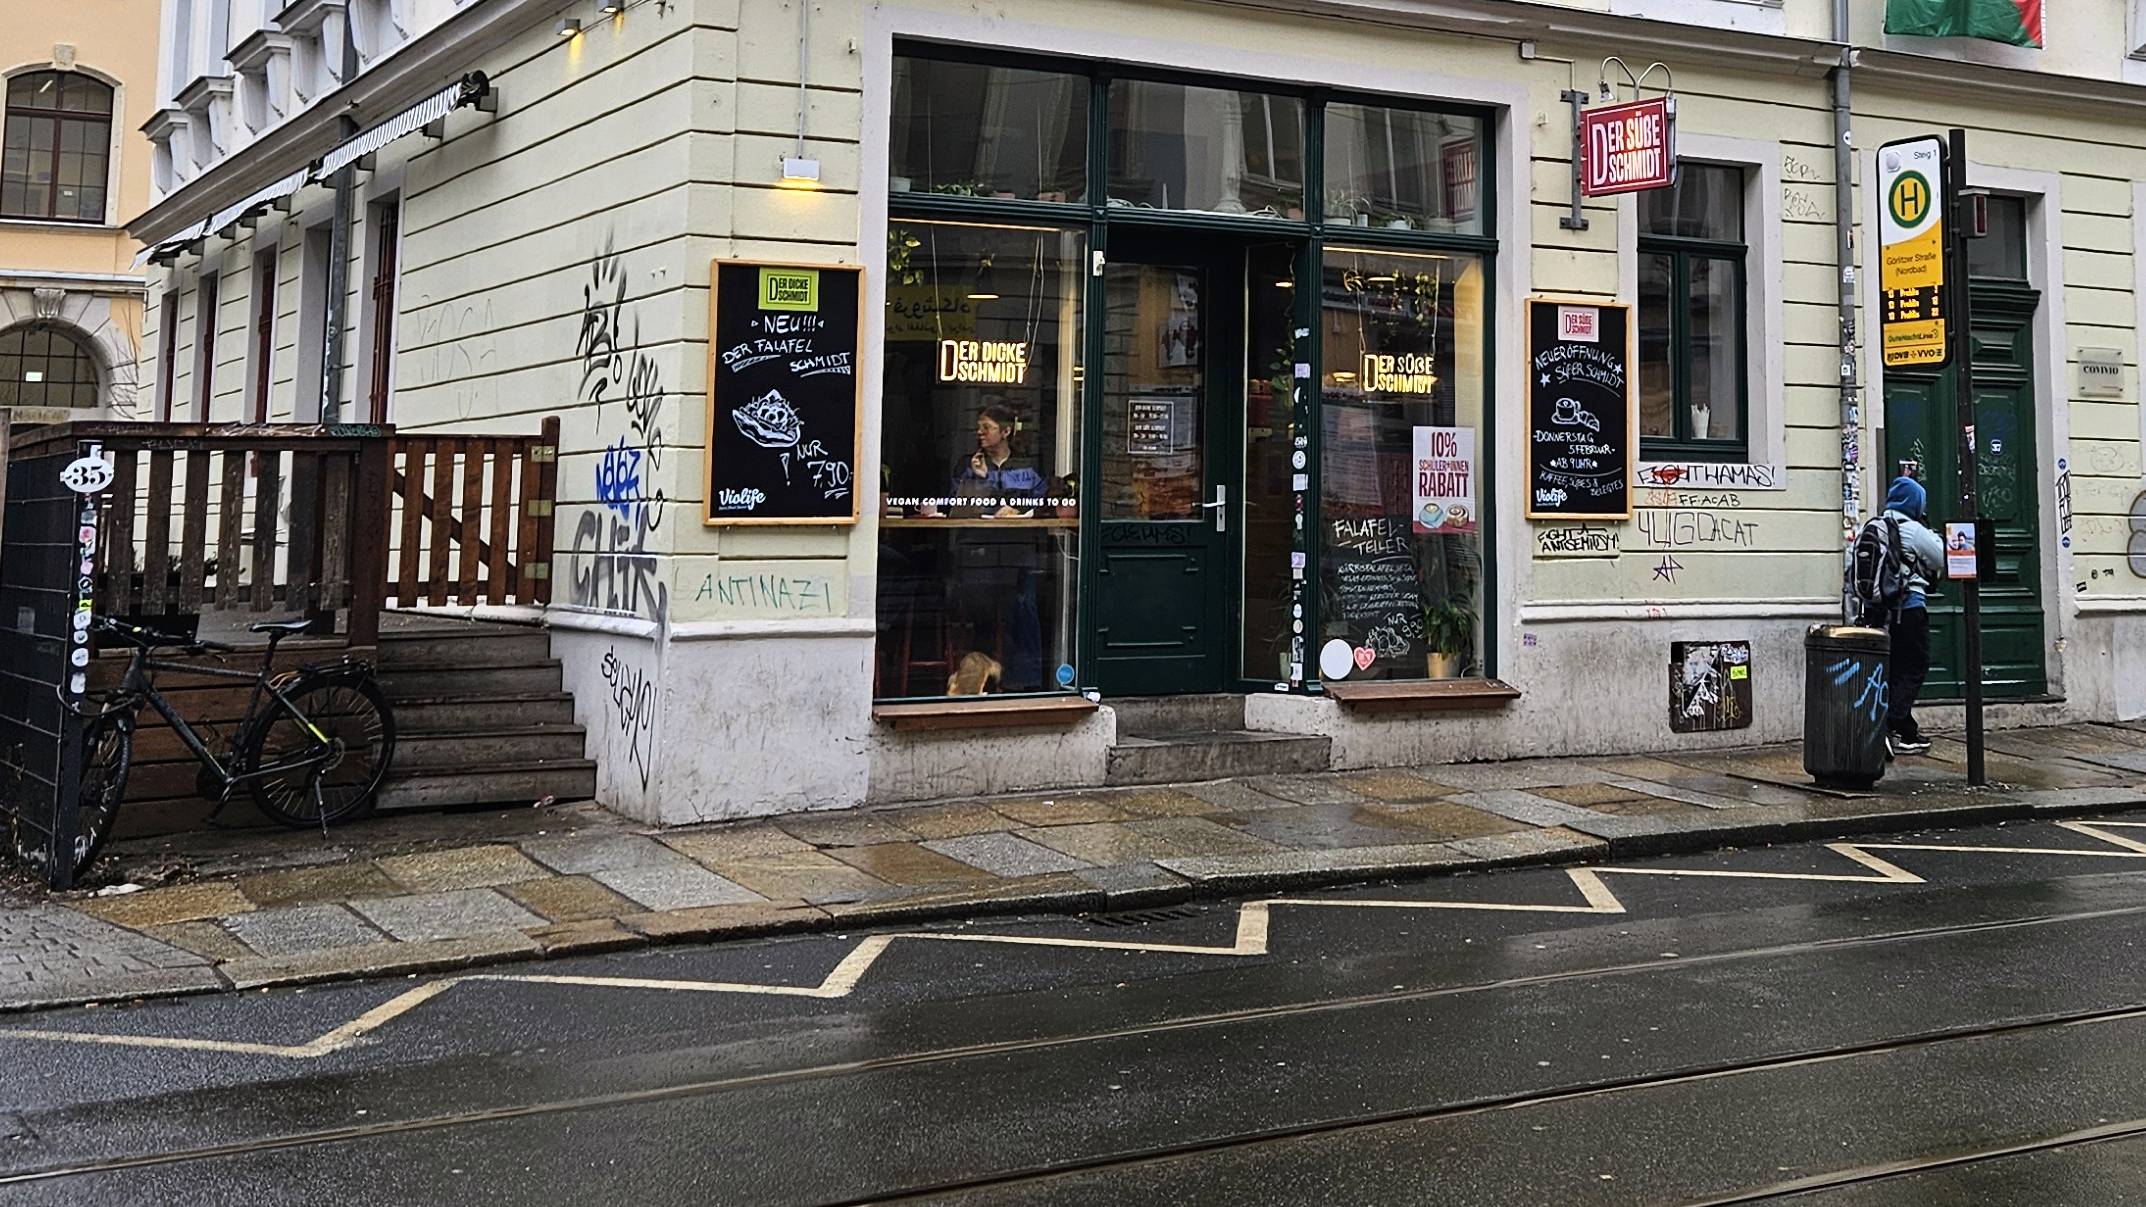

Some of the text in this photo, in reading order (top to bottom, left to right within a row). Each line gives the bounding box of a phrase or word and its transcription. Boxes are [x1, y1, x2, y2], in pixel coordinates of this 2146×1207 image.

[1592, 120, 1624, 186] DER
[1608, 148, 1661, 183] SCHMIDT
[769, 277, 808, 300] DER DICKE
[778, 289, 808, 301] SCHMIDT
[722, 339, 812, 364] DER FALAFEL
[790, 352, 850, 373] SCHMIDT
[940, 340, 1026, 381] DER DICKE
[1917, 349, 1935, 358] VVO
[957, 362, 1026, 384] SCHMIDT
[1364, 354, 1394, 392] DER
[1585, 364, 1624, 388] SCHMIDT
[2083, 366, 2119, 374] COVIVIO
[797, 440, 828, 461] NUR
[1432, 432, 1457, 457] 10%
[73, 465, 106, 487] 35
[1419, 472, 1469, 497] RABATT
[1704, 465, 1775, 487] HAMAS!
[718, 488, 766, 510] Violife
[886, 497, 919, 506] VEGAN
[922, 497, 967, 506] COMFORT
[970, 497, 997, 506] FOOD
[1009, 497, 1044, 506] DRINKS
[1047, 497, 1057, 506] TO
[1061, 497, 1076, 506] GO
[1535, 487, 1568, 507] Violife
[1353, 537, 1409, 555] TELLER
[1388, 613, 1407, 625] NUR
